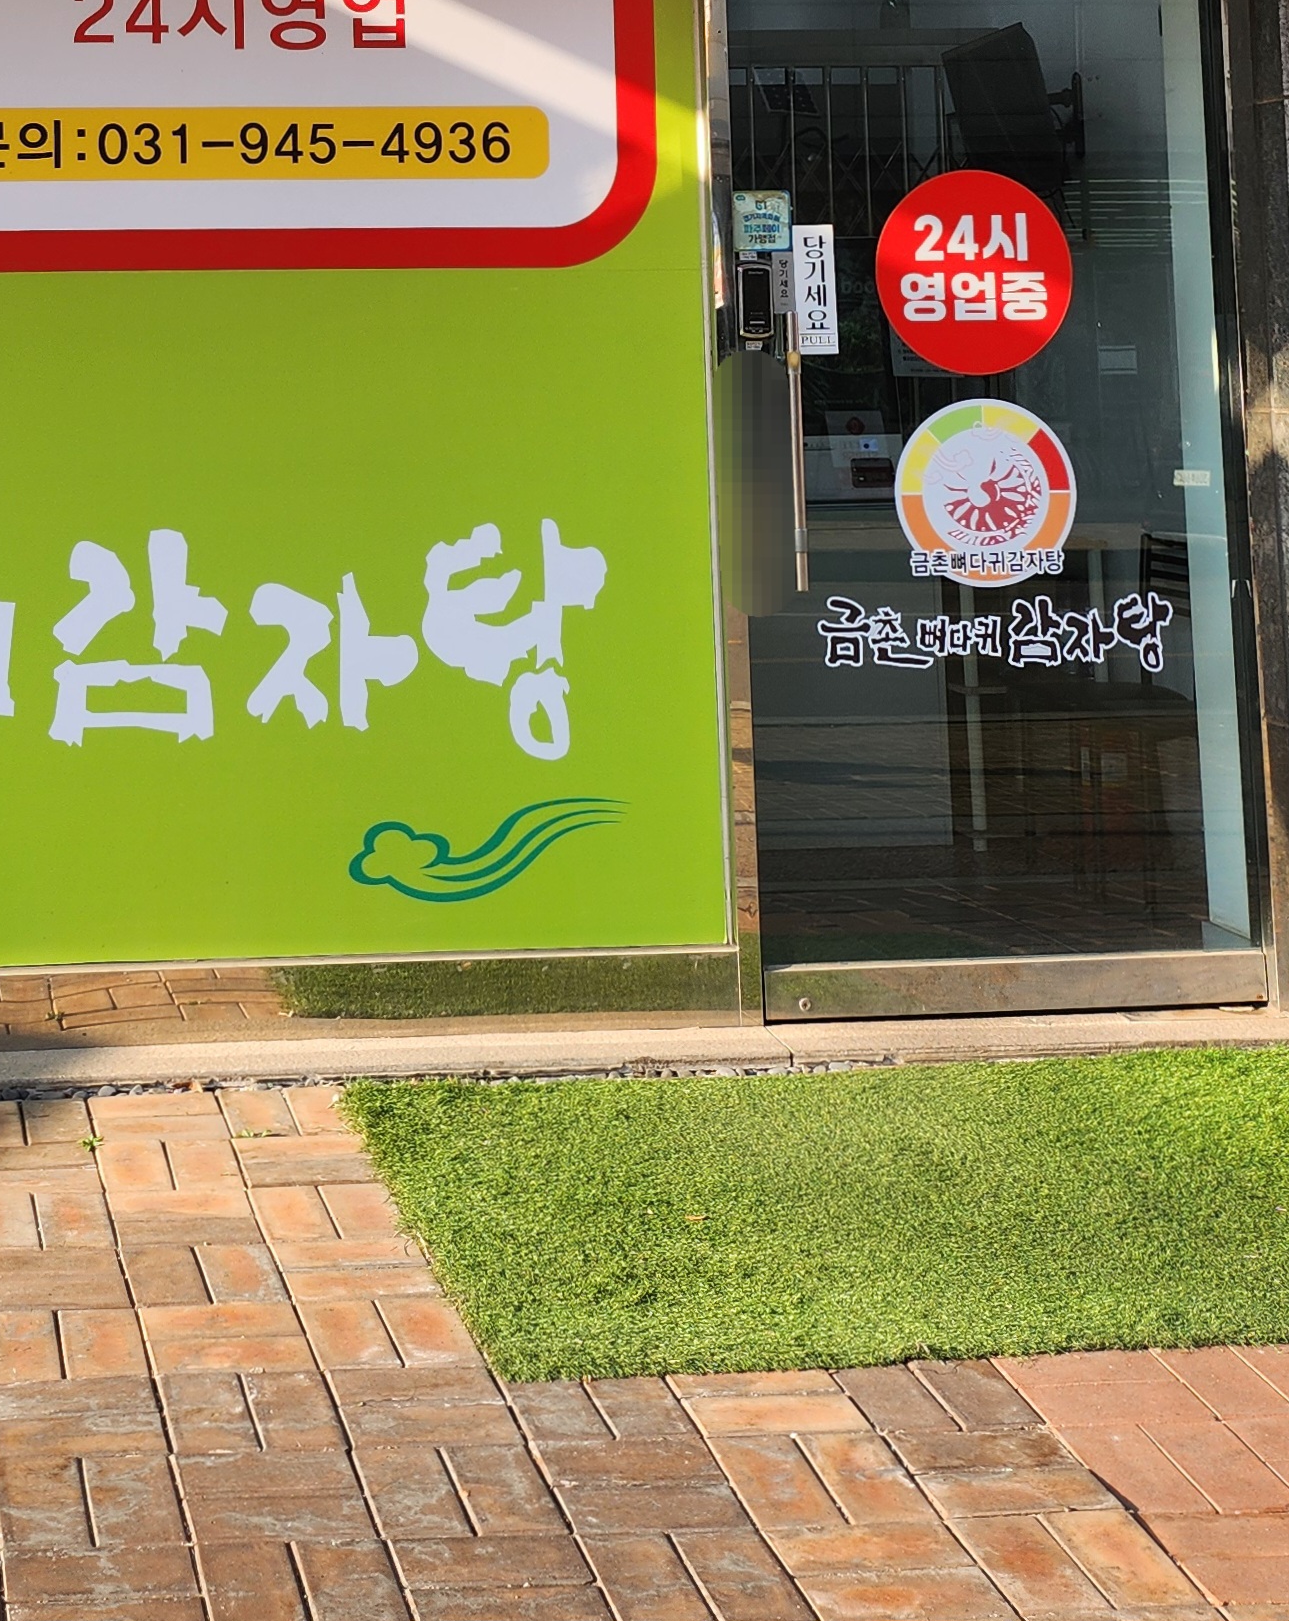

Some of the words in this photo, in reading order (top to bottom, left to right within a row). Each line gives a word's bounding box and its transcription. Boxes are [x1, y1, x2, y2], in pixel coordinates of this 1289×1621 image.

[914, 212, 1029, 262] 24시
[803, 235, 830, 330] 당기세요
[900, 271, 1048, 321] 영업중
[801, 335, 836, 345] PULL
[910, 549, 1064, 576] 금촌뼈다귀감자탕
[49, 518, 608, 761] 감자탕
[818, 596, 934, 669] 금촌
[1008, 591, 1174, 672] 감자탕
